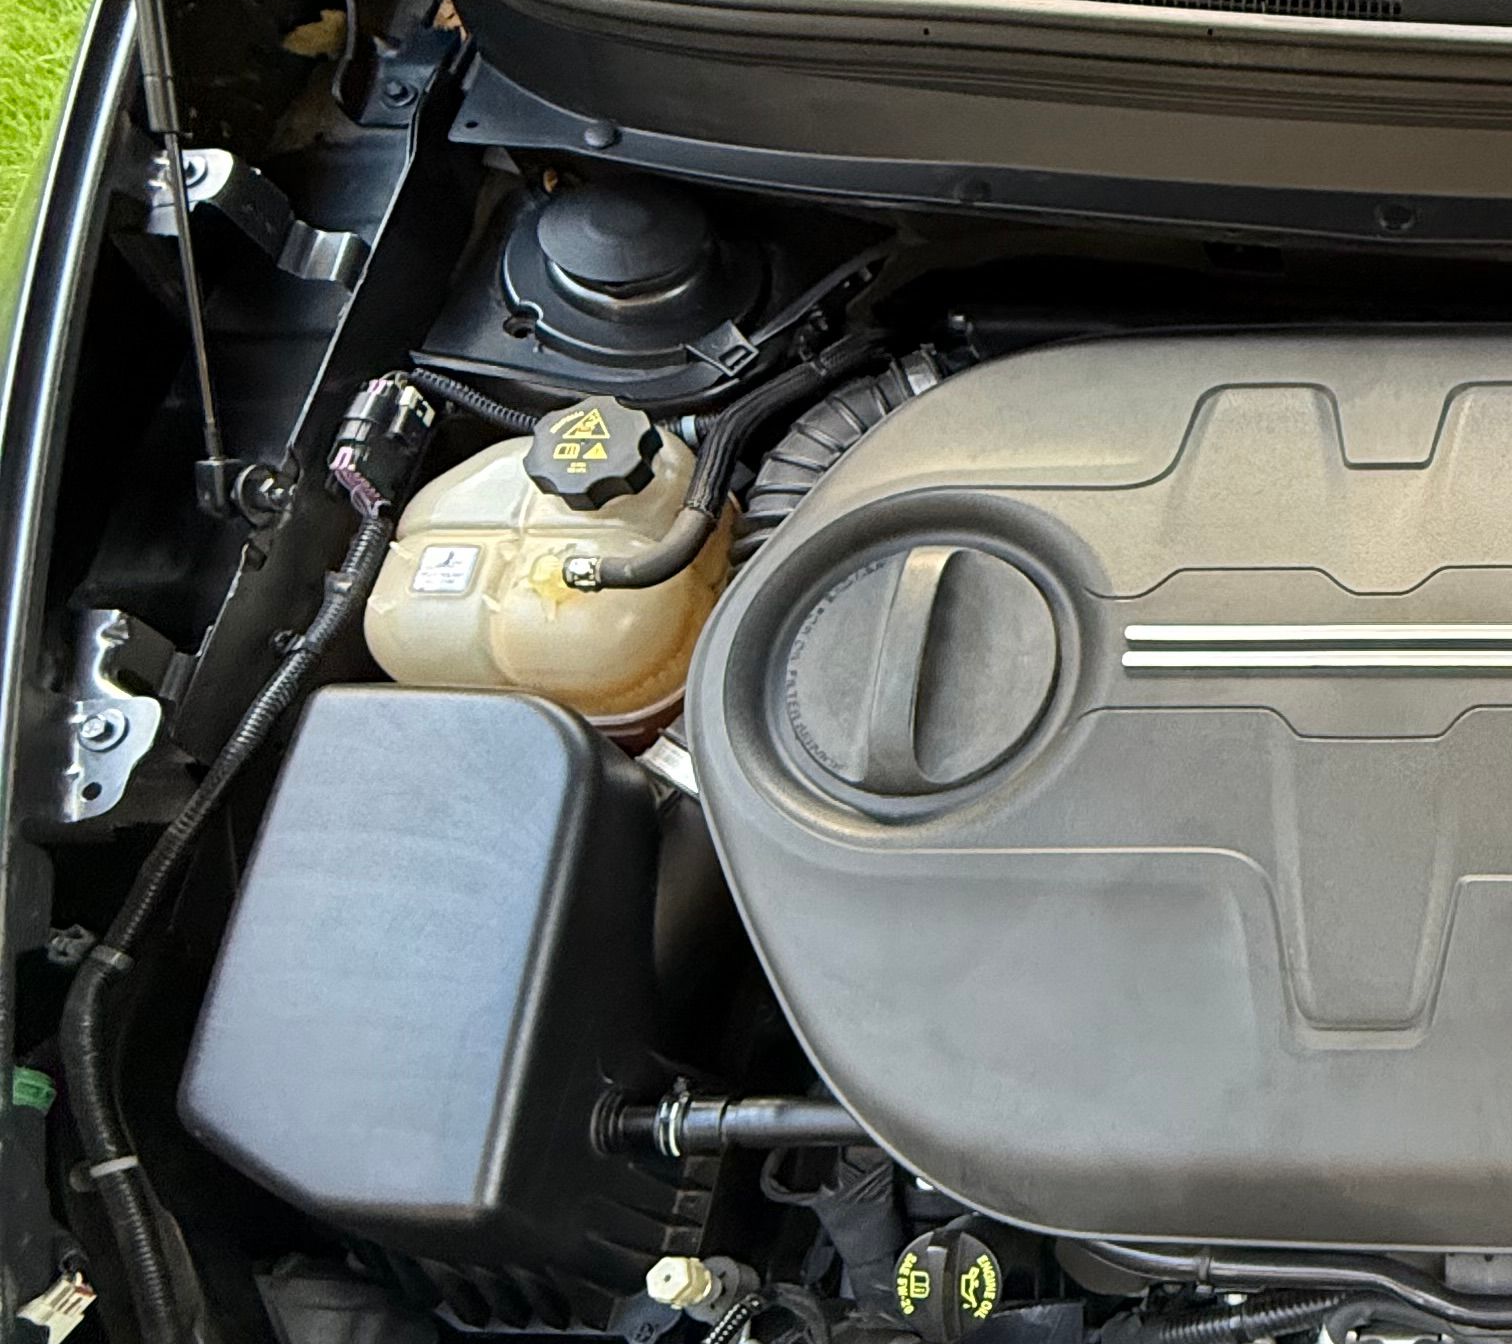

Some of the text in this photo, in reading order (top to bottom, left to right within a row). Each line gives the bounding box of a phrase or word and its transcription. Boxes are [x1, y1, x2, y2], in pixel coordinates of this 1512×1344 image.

[898, 1252, 918, 1276] SAE
[973, 1254, 997, 1319] ENGINE OIL
